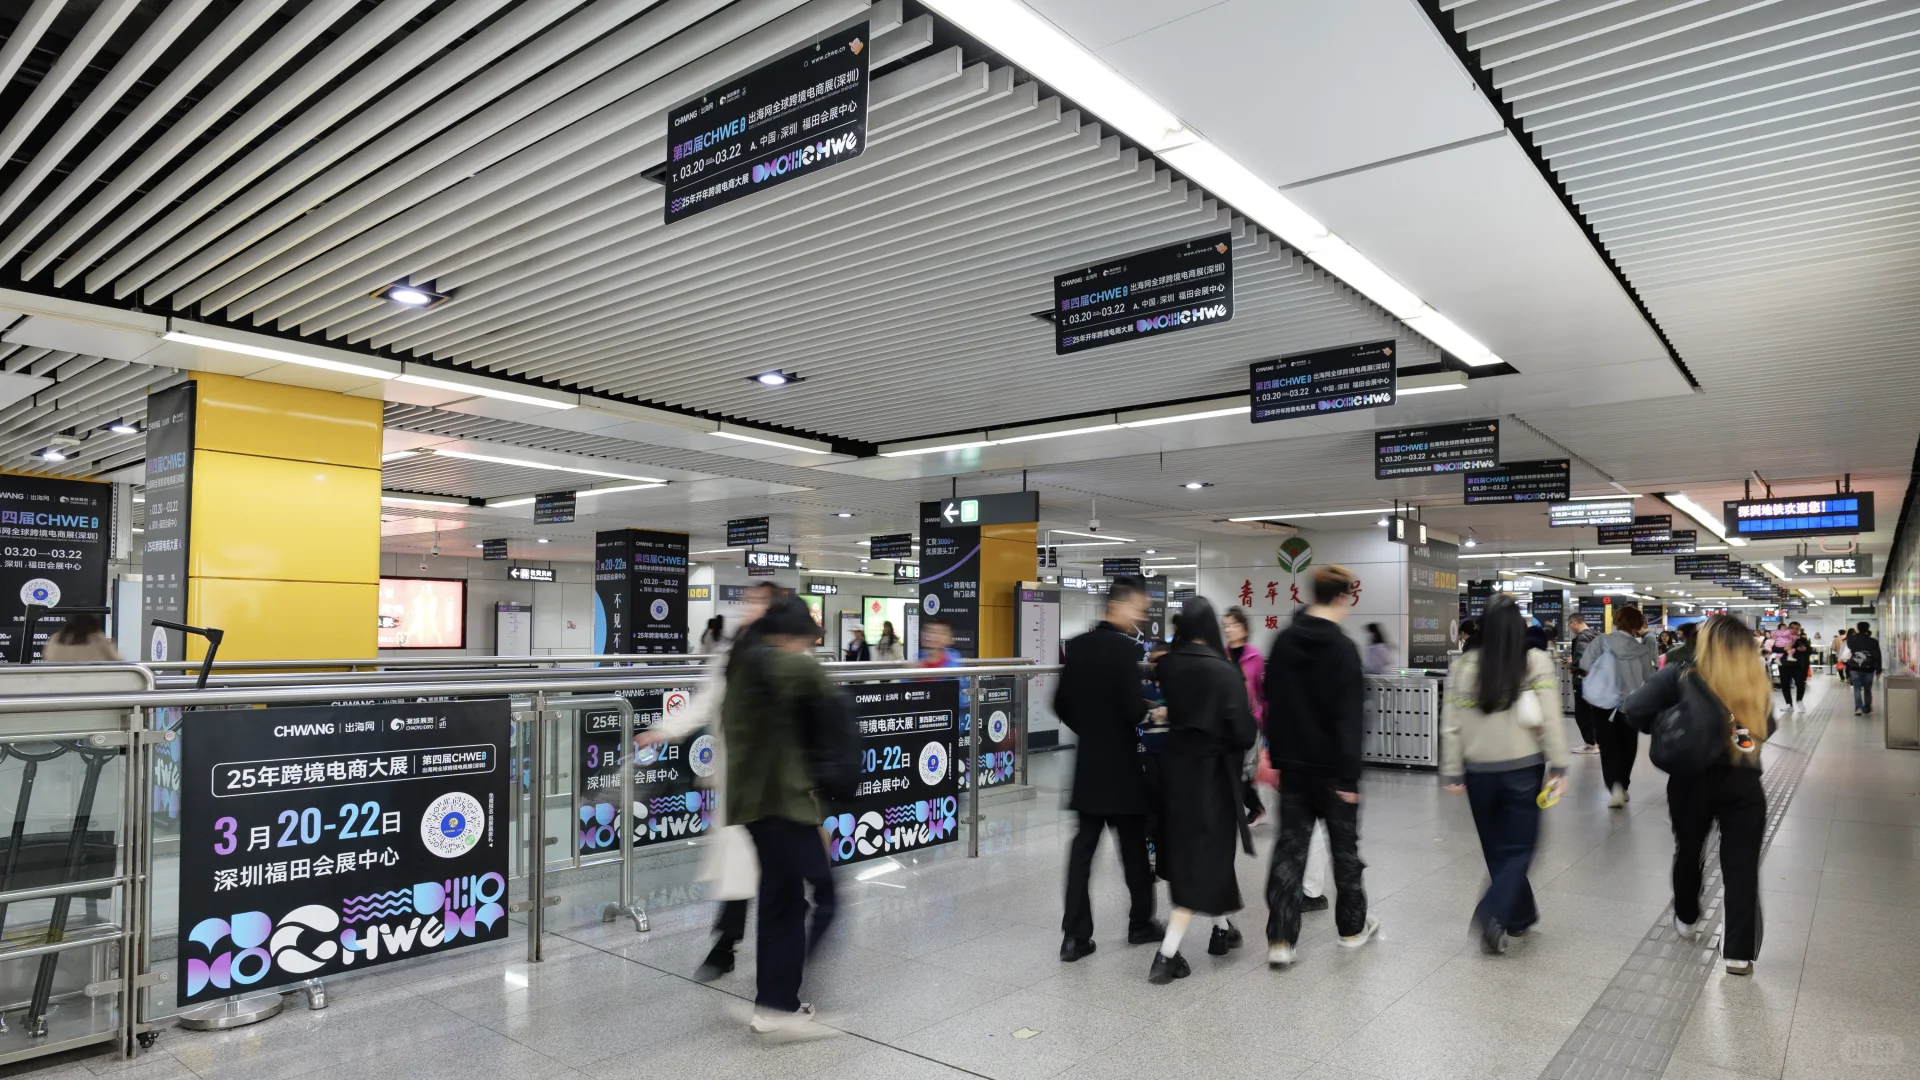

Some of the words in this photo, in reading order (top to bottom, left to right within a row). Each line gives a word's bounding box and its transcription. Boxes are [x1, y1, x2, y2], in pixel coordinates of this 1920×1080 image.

[811, 46, 845, 64] www.chwe.cn
[748, 68, 859, 124] 出海网全球跨境电商展(深圳)
[674, 110, 697, 126] CHWANG
[680, 159, 704, 179] 03.20
[716, 143, 741, 165] 03.22
[802, 100, 857, 131] 福田会展中心
[682, 173, 749, 208] 25年开年跨境电商大展
[1061, 277, 1082, 287] CHWANG
[1130, 262, 1225, 292] 出海网全球跨境电商展(深圳)
[1069, 311, 1092, 324] 03.20
[1102, 303, 1125, 316] 03.22
[1179, 283, 1225, 300] 福田会展中心
[1072, 324, 1134, 344] 25年开年跨境电商大展
[1262, 392, 1281, 401] 03.20
[1290, 388, 1309, 397] 03.22
[1353, 377, 1390, 388] 福田会展中心
[1738, 501, 1826, 517] 深圳地铁欢迎您!
[0, 527, 98, 540] 网全球跨境电商展(深圳)
[4, 547, 37, 557] 03.20
[51, 549, 82, 559] 03.22
[1834, 559, 1855, 568] 乘车
[1238, 579, 1363, 607] 青年文号
[856, 694, 881, 703] CHWANG
[274, 723, 334, 738] CHWANG
[345, 721, 375, 733] 出海网
[226, 756, 408, 790] 25年跨境电商大展
[422, 762, 486, 773] 出海网全球跨境电商展(深圳)
[587, 768, 679, 790] 深圳福会展中心
[213, 846, 400, 892] 深圳福田会展中心
